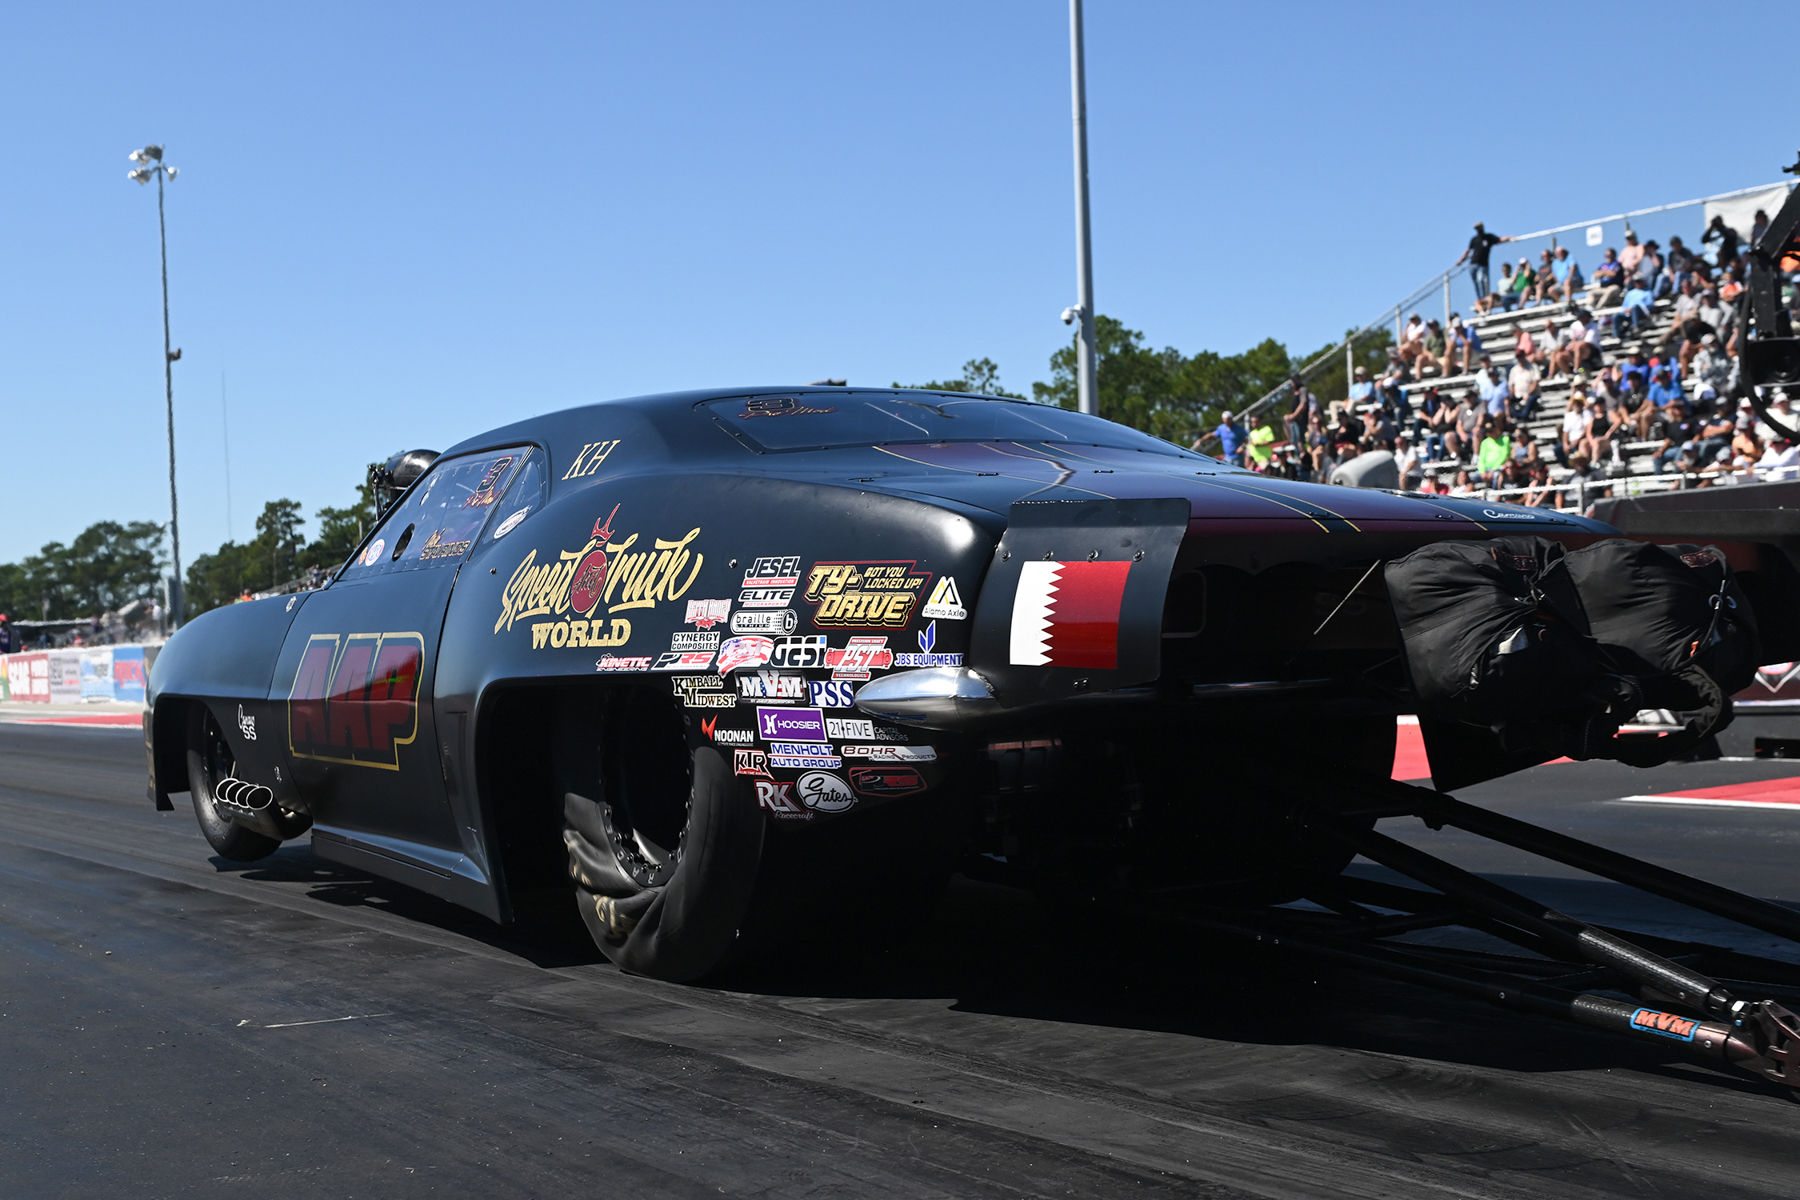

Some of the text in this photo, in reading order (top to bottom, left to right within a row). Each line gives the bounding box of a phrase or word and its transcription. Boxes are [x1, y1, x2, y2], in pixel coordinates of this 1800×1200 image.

[561, 439, 621, 480] KH
[745, 557, 800, 579] JESEL
[864, 566, 907, 578] GOT YOU
[494, 539, 597, 635] Speed
[586, 527, 704, 618] Truck
[805, 565, 865, 601] TY-
[865, 578, 924, 590] LOCKED UP!
[740, 590, 794, 600] ELITE
[814, 591, 917, 628] DRIVE
[924, 607, 965, 618] Alamo Axle
[736, 613, 772, 624] braille
[531, 617, 632, 650] WORLD
[673, 632, 720, 643] CYNERGY
[671, 642, 719, 651] COMPOSITES
[598, 656, 653, 668] KINETIC
[895, 654, 963, 666] JBS EQUIPMENT
[672, 675, 724, 695] KIMBALL
[739, 669, 805, 698] MVM
[684, 687, 737, 707] MIDWEST
[807, 681, 856, 706] PSS
[778, 720, 821, 730] HOOSIER
[844, 722, 872, 737] FIVE
[243, 725, 257, 740] SS
[714, 730, 754, 742] NOONAN
[772, 743, 833, 756] MENHOLT
[843, 746, 904, 760] BOHR
[771, 758, 841, 768] AUTO GROUP
[756, 781, 801, 812] RK
[803, 776, 856, 808] Gates
[774, 810, 815, 820] Racecraft
[1634, 1010, 1696, 1036] MVM
